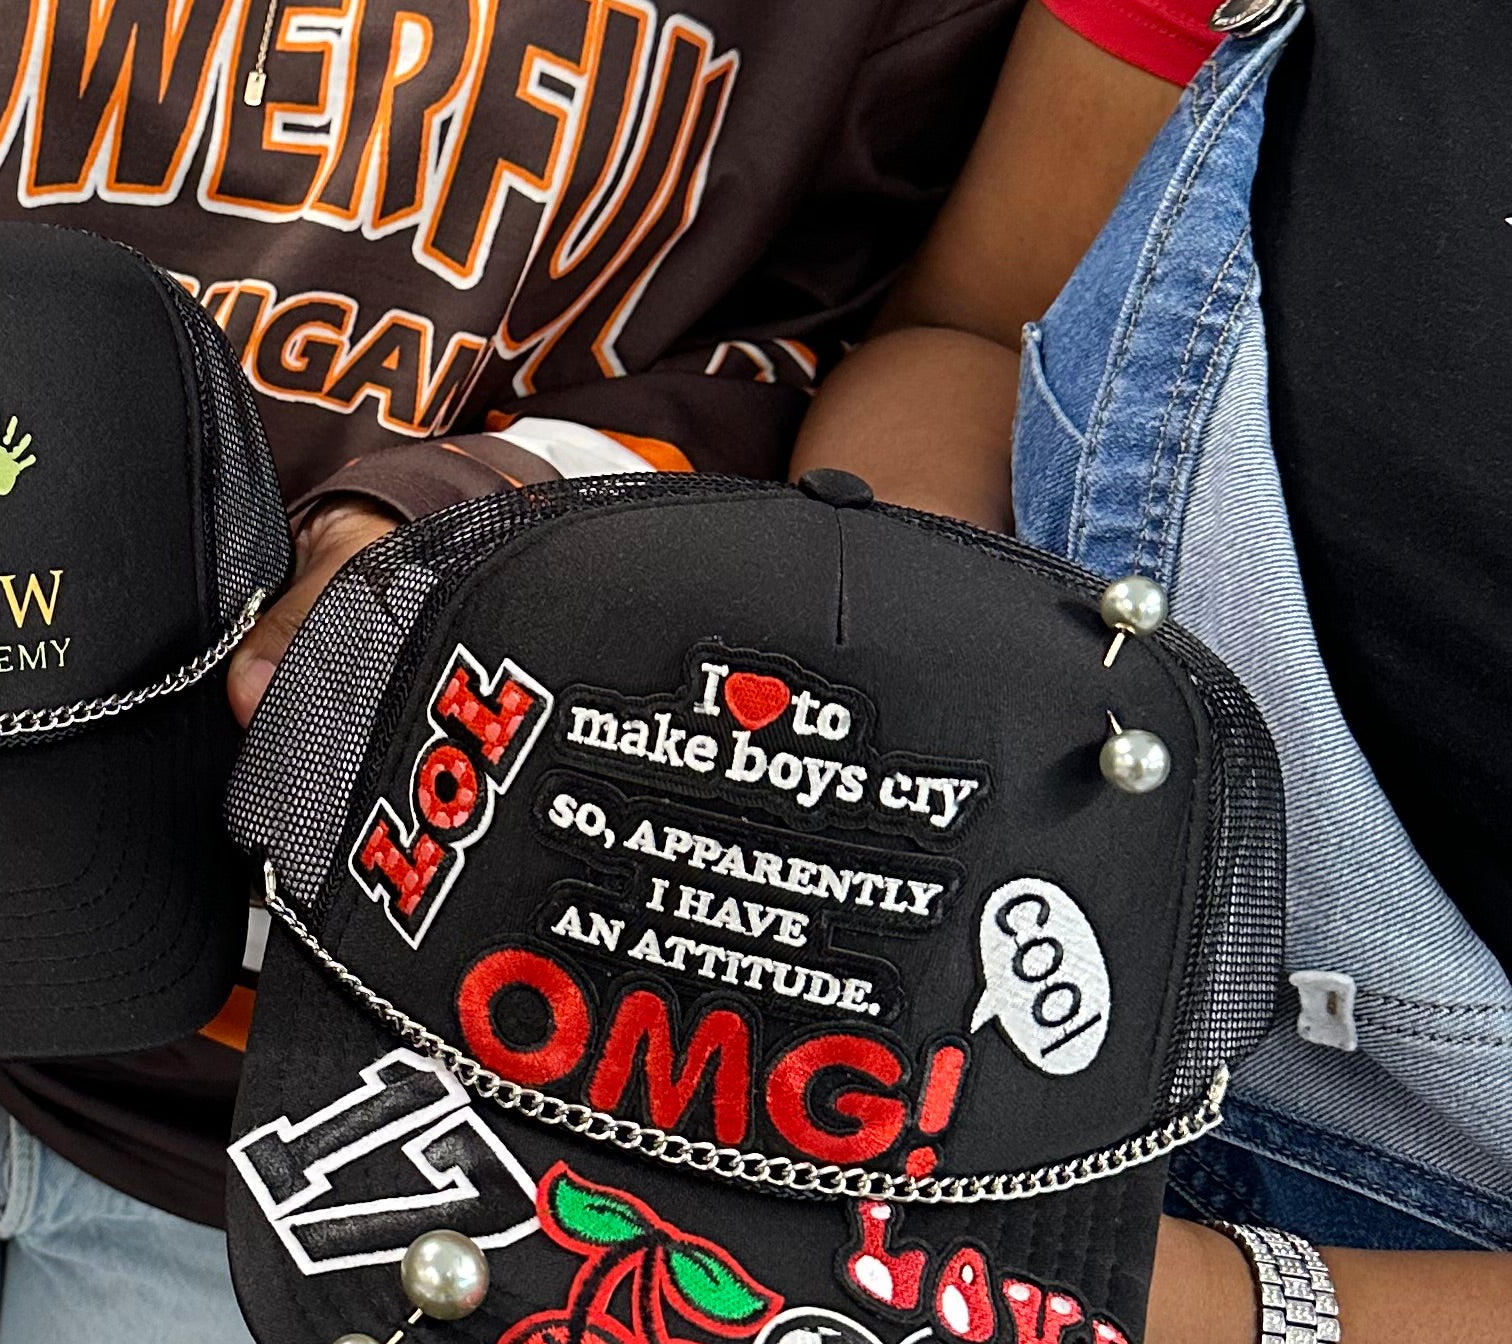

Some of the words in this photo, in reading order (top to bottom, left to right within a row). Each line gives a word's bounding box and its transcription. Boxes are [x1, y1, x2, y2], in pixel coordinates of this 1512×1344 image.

[694, 662, 729, 717] I
[790, 690, 852, 741] to
[354, 654, 546, 936] LOL
[567, 706, 719, 773] make
[724, 730, 869, 809] boys
[879, 771, 980, 829] cry
[548, 793, 616, 849] SO,
[622, 819, 944, 917] APPARENTLY
[645, 877, 670, 914] I
[674, 884, 810, 948] HAVE
[550, 906, 626, 953] AN
[628, 929, 882, 1017] ATTITUDE.
[456, 947, 966, 1180] OMG!
[226, 1046, 542, 1276] 17
